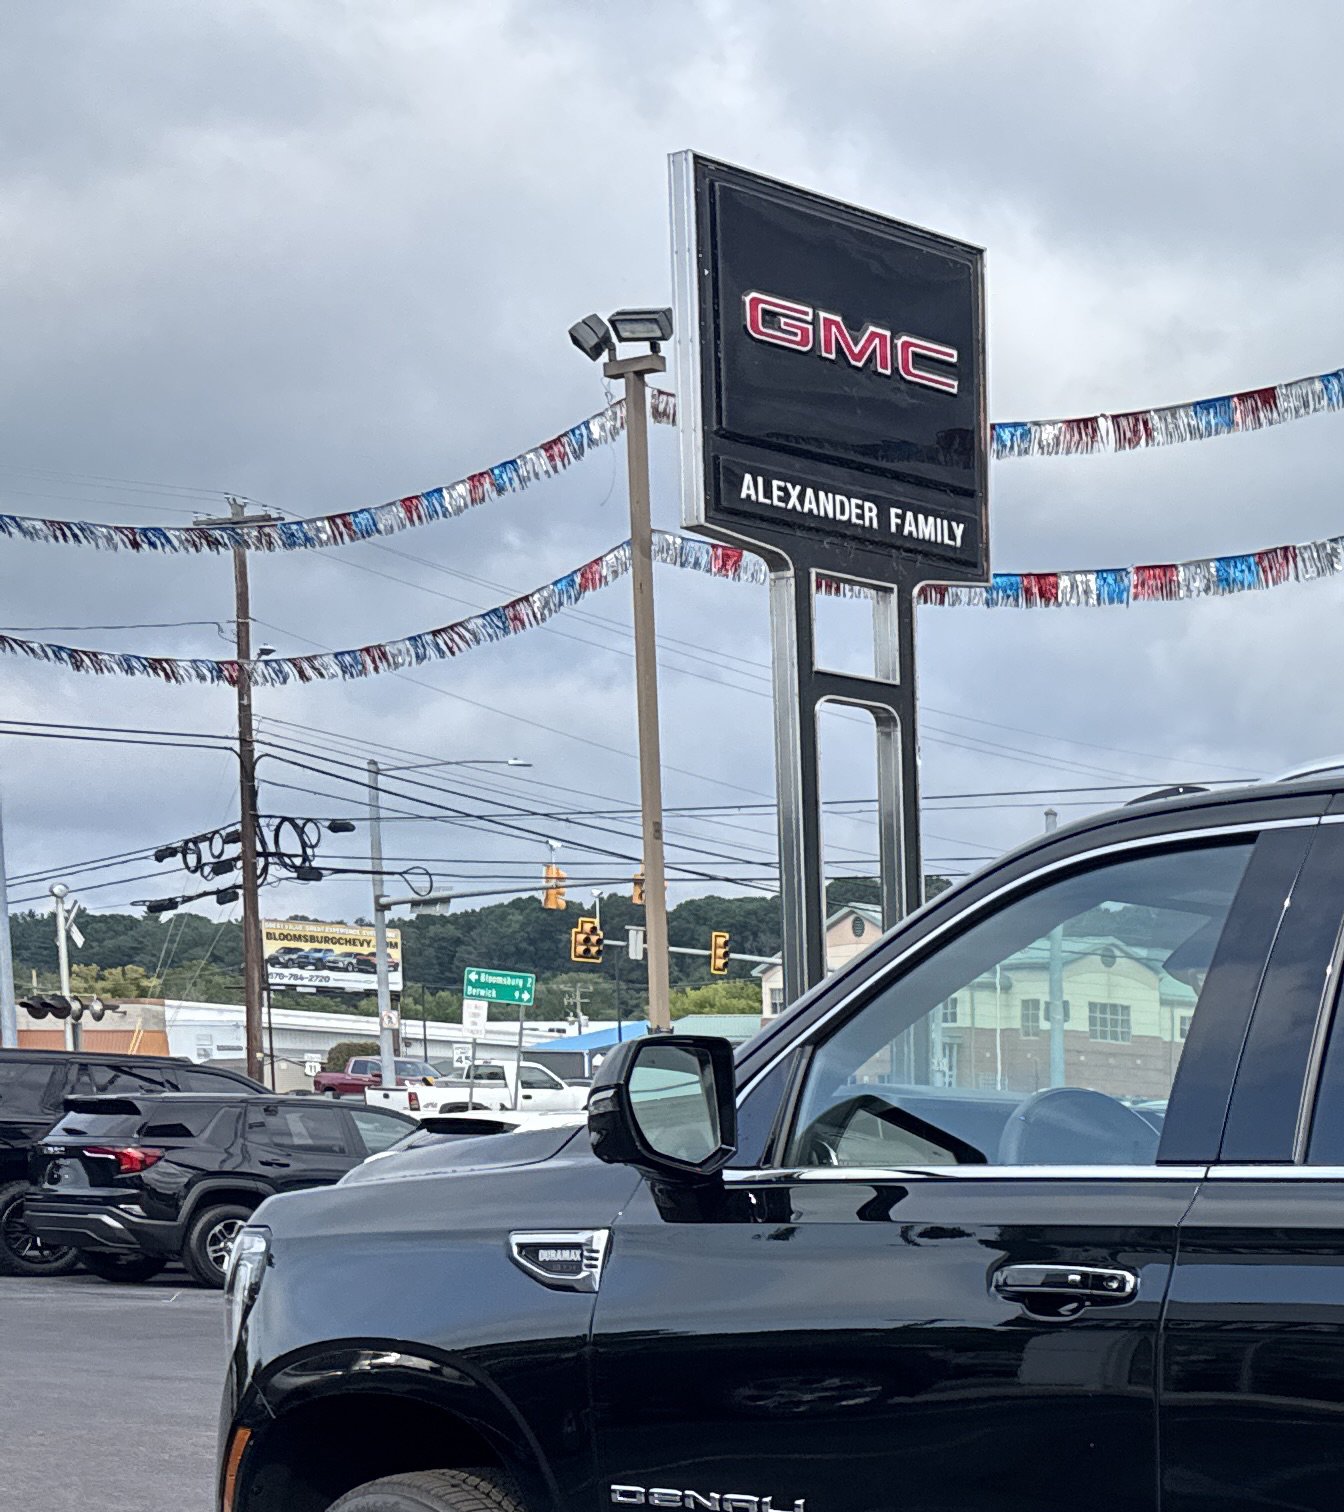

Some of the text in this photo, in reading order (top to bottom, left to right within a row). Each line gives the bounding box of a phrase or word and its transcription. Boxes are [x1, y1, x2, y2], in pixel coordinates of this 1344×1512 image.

[744, 292, 957, 394] GMC
[740, 473, 965, 548] ALEXANDER FAMILY
[480, 973, 524, 989] Bloomsburg
[467, 985, 497, 998] Berwick
[538, 1249, 582, 1261] DURAMAX
